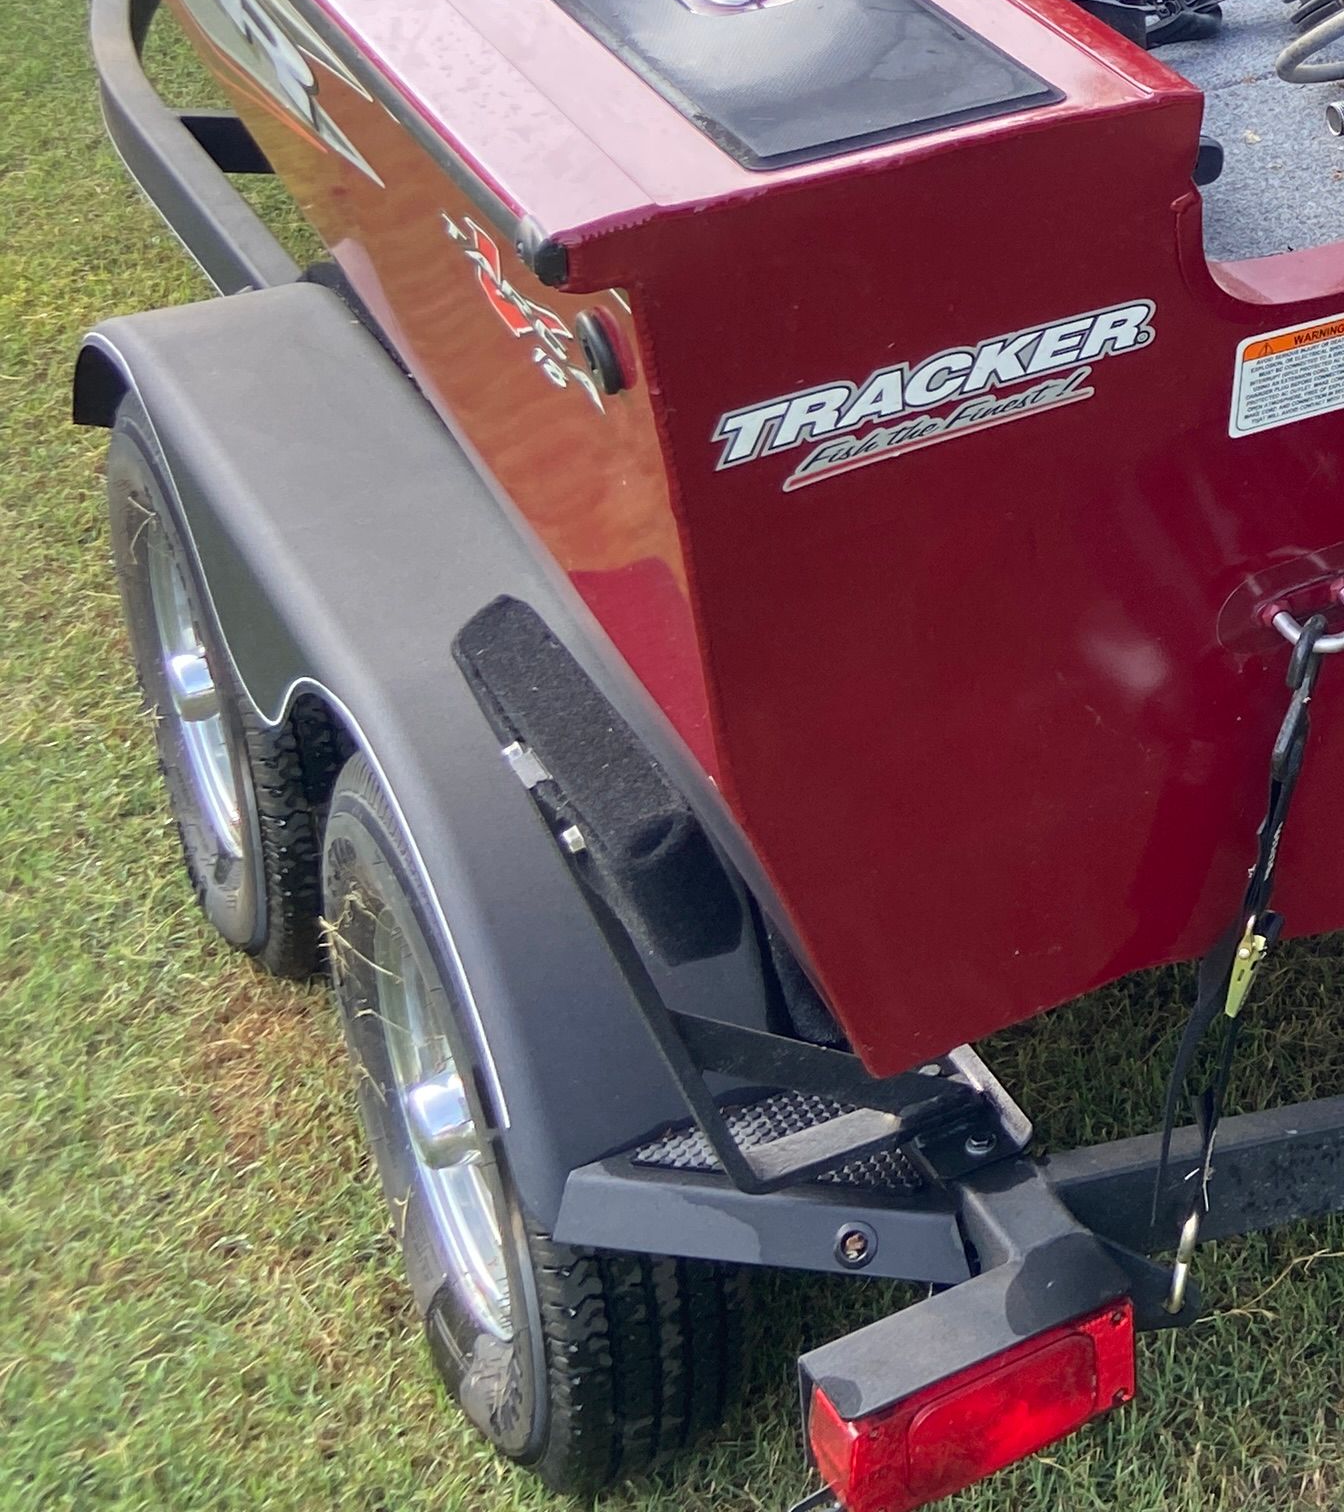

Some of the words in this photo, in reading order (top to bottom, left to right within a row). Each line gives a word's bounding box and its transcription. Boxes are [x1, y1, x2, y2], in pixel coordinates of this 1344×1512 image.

[1293, 323, 1344, 345] WARNING
[722, 304, 1151, 465] TRACKER
[888, 418, 936, 446] the
